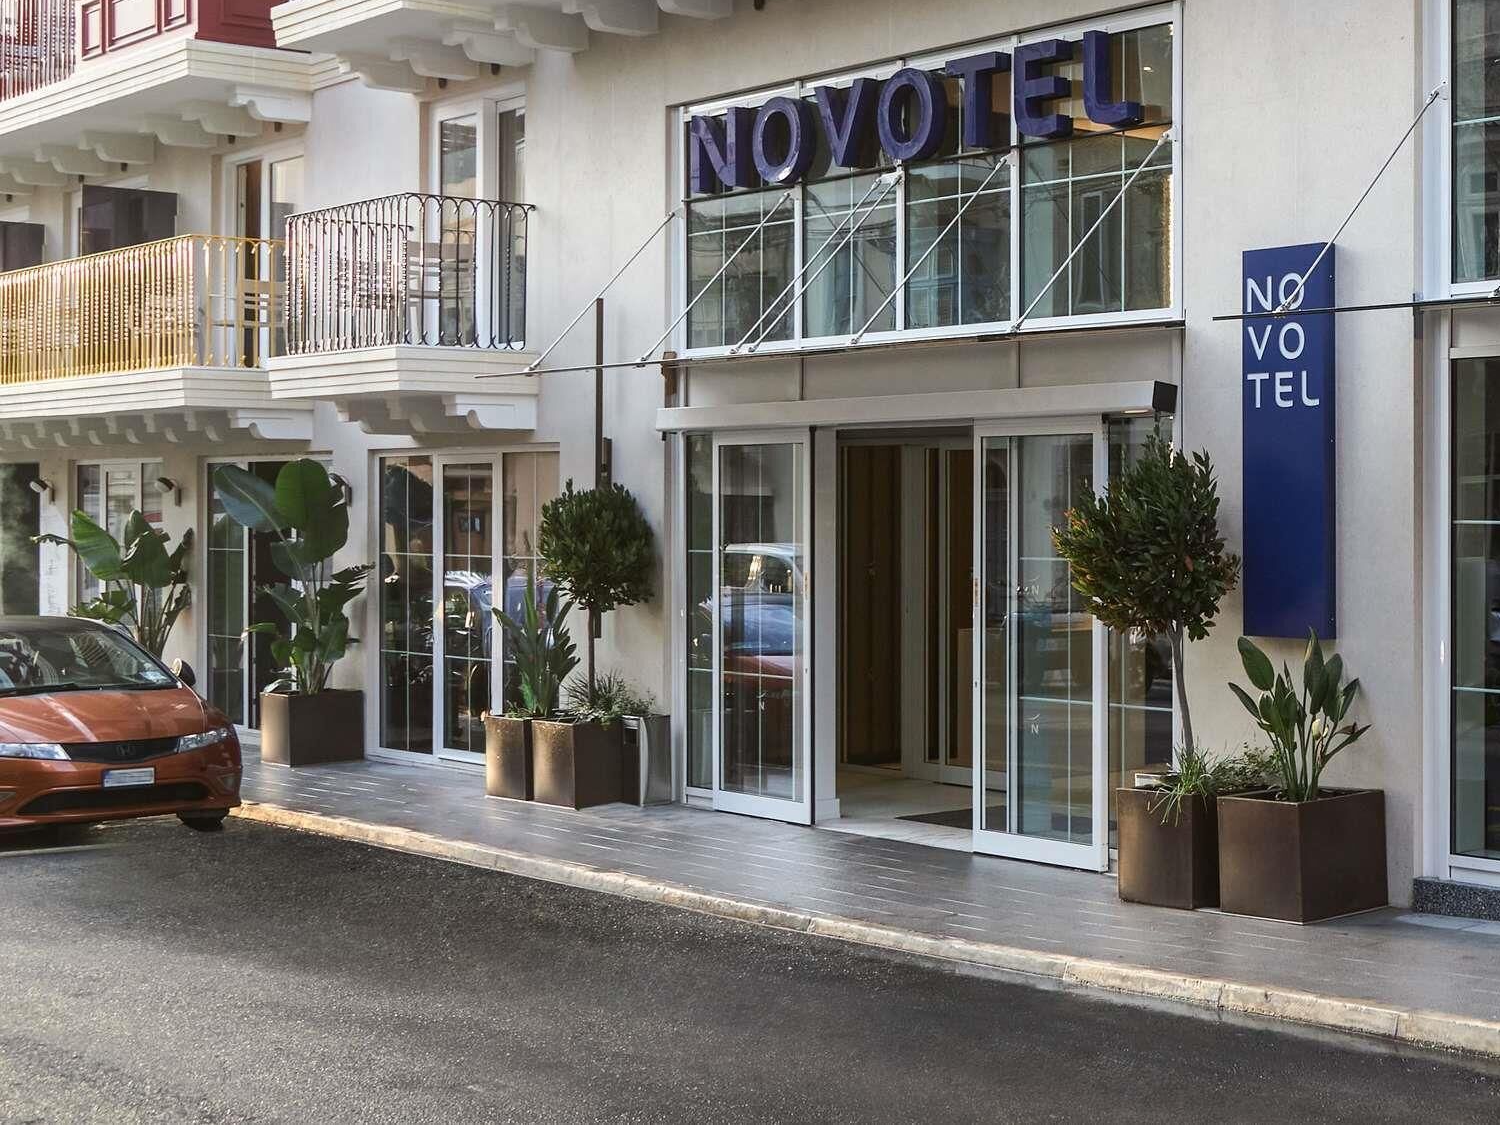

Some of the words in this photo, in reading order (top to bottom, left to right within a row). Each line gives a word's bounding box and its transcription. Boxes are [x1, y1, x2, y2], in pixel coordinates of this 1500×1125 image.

[691, 30, 1144, 194] NOVOTEL
[1246, 272, 1305, 313] NO
[1247, 322, 1306, 360] VO
[1246, 370, 1320, 408] TEL
